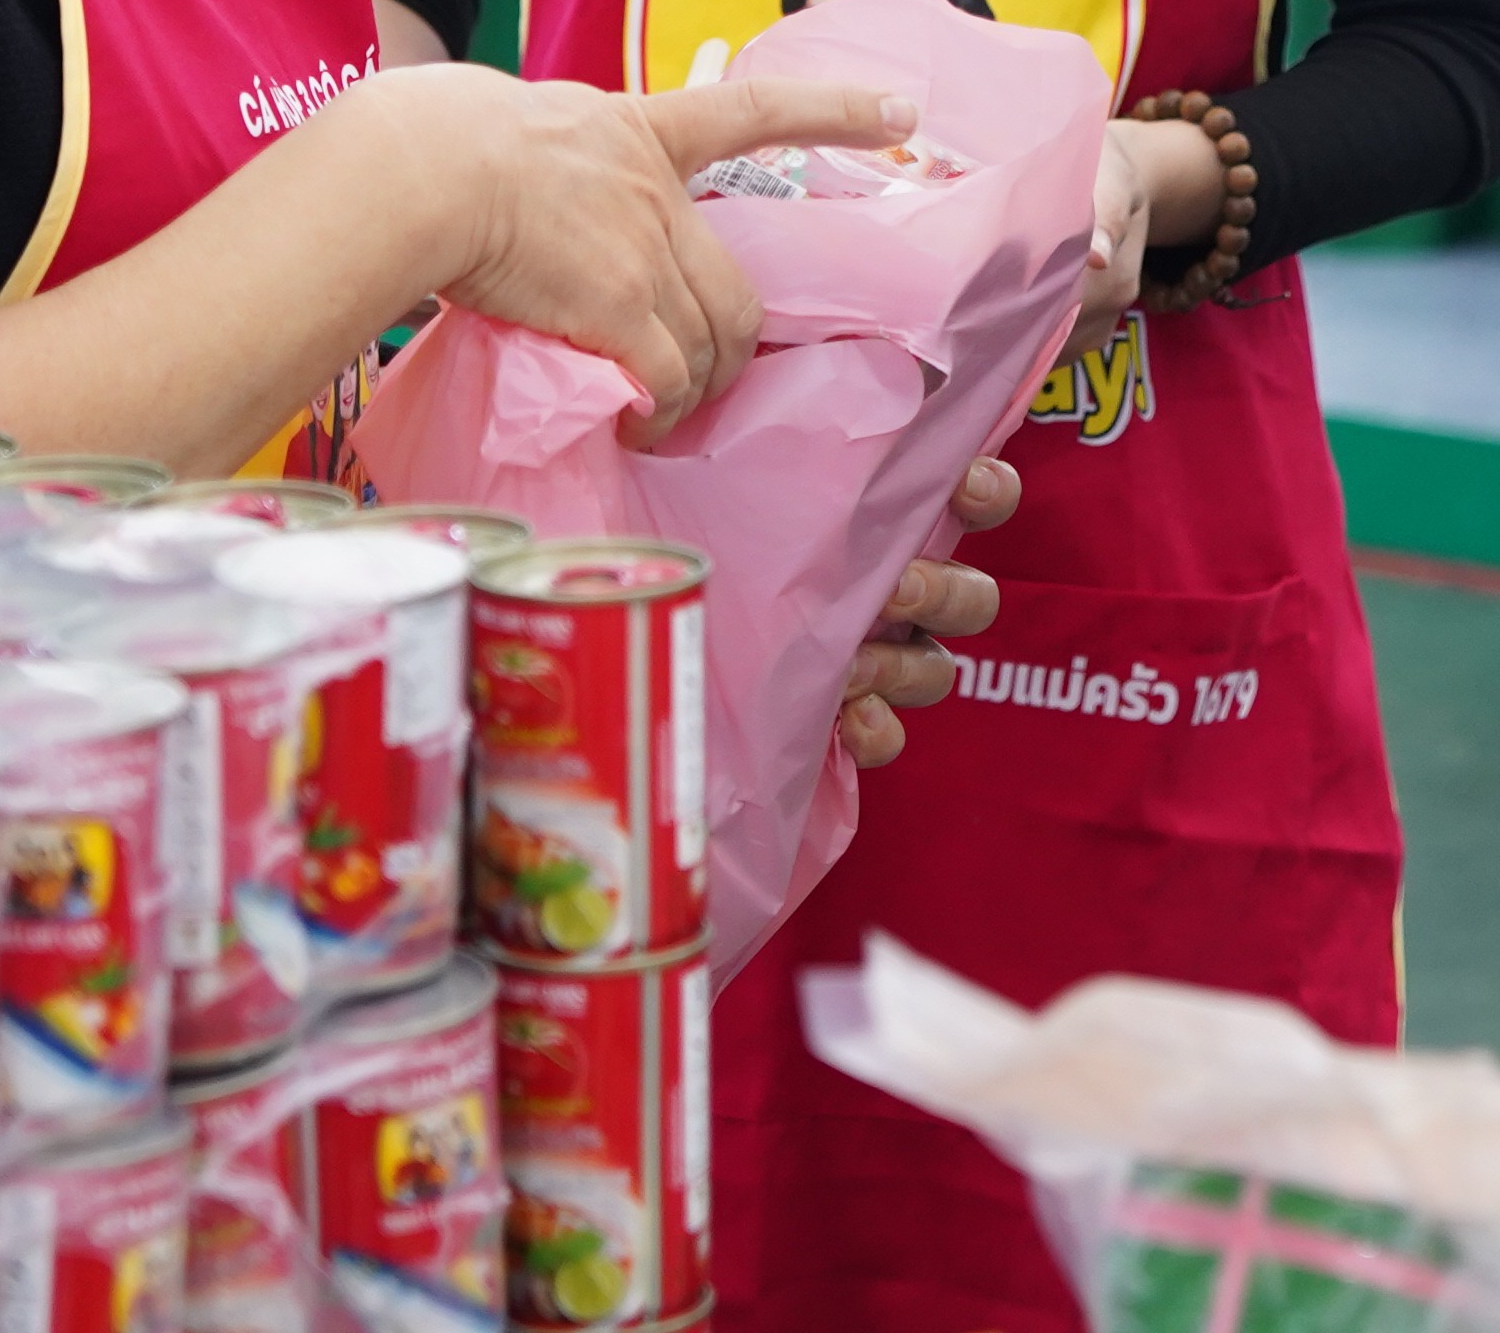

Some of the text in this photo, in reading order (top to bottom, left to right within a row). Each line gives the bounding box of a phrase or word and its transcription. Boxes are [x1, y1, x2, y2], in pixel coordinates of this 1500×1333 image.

[239, 75, 280, 138] CÁ
[296, 80, 317, 117] 3
[309, 59, 339, 110] CÔ
[1026, 309, 1156, 446] ay!
[954, 654, 1180, 726] ามแม่ครัว
